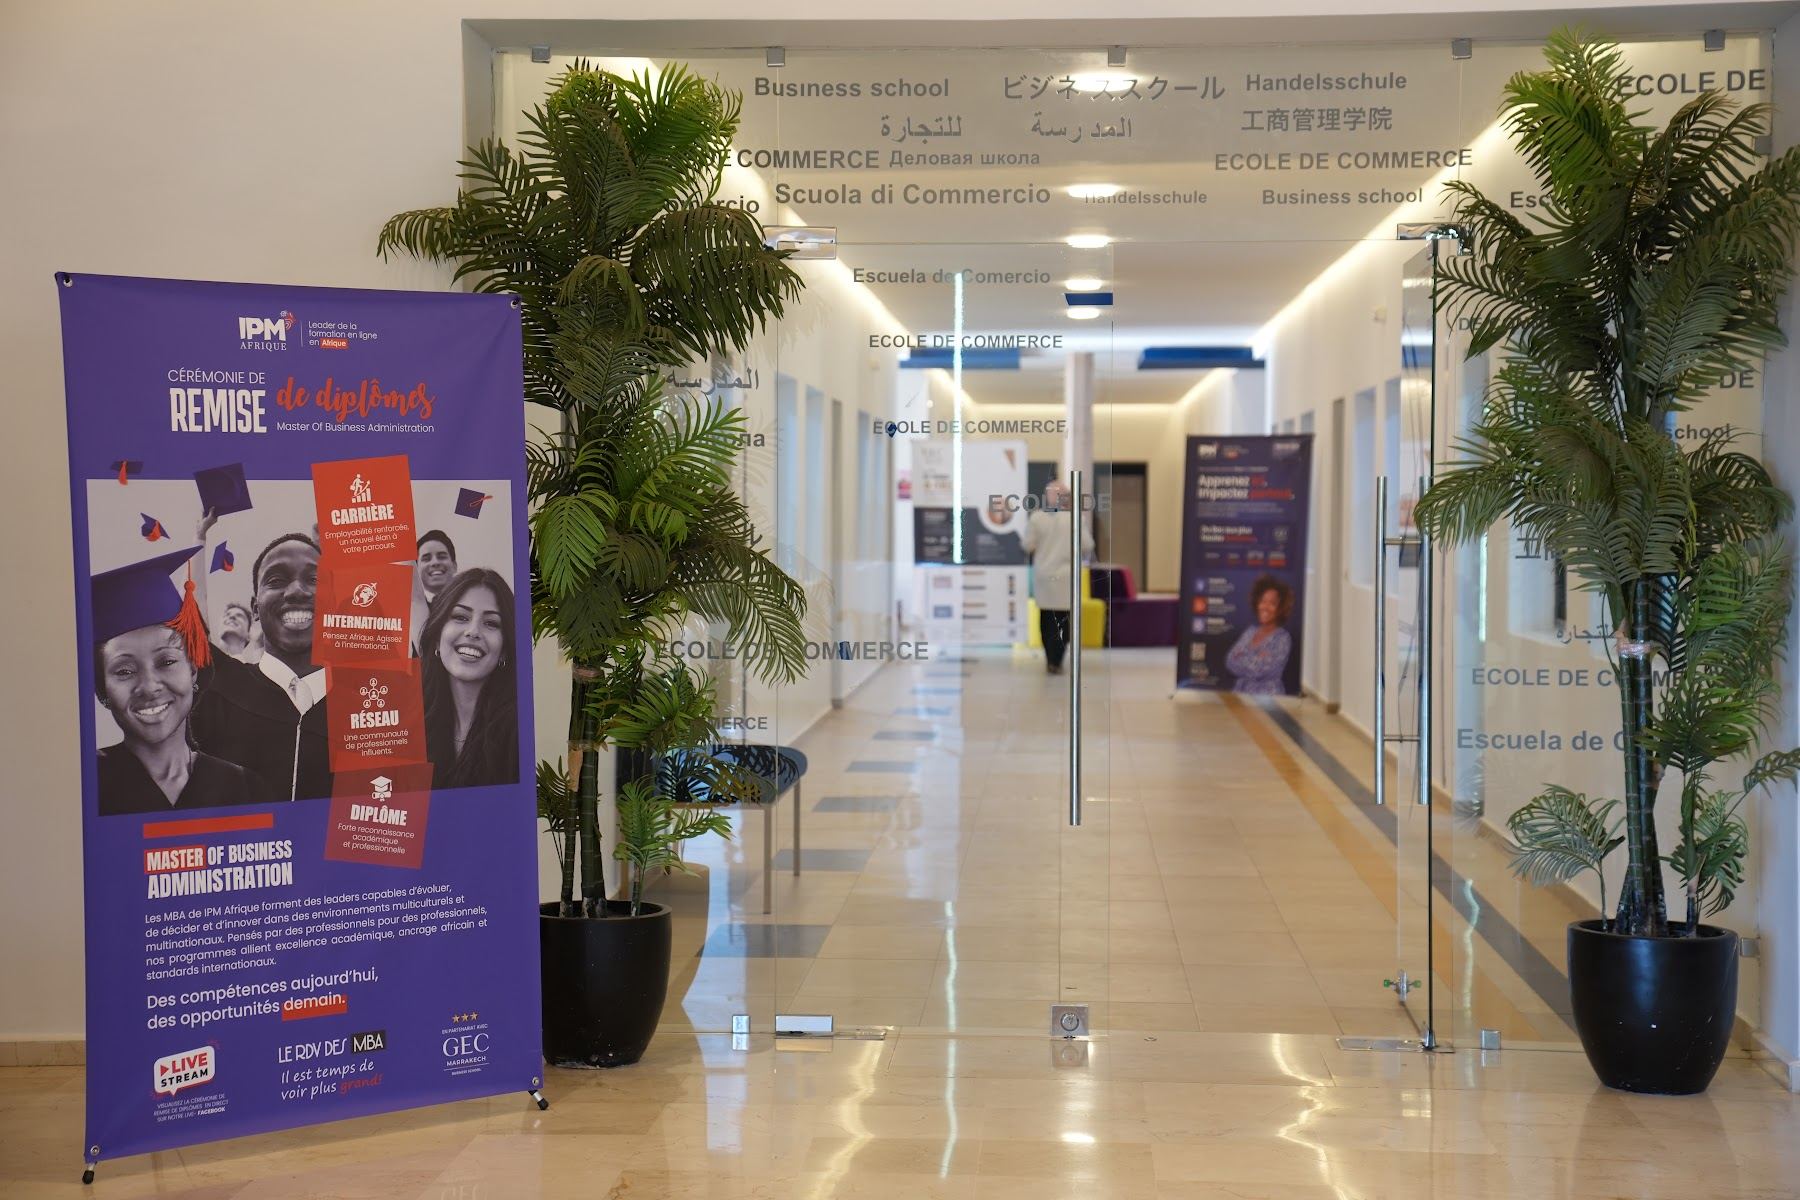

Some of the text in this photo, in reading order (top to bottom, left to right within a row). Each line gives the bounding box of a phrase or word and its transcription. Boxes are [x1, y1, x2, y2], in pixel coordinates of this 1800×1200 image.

[754, 77, 949, 97] Business school
[1246, 72, 1407, 92] Handelsschule
[1618, 69, 1766, 96] ECOLE DE
[880, 114, 962, 144] للتجارة
[1241, 107, 1393, 132] 工商管理学院
[737, 150, 880, 169] COMMERCE
[889, 150, 1040, 168] Деловая школа
[1215, 149, 1473, 171] ECOLE DE COMMERCE
[775, 183, 1051, 205] Scuola di Commercio
[1262, 188, 1423, 205] Business school
[853, 268, 1050, 284] Escuela de Comercio
[238, 316, 286, 341] IPM
[308, 320, 357, 330] Leader de la
[308, 330, 346, 338] formation
[360, 331, 378, 341] ligne
[322, 340, 347, 348] Afrique
[869, 335, 1063, 348] ECOLE DE COMMERCE
[240, 342, 287, 352] AFRIQUE
[168, 368, 266, 384] CÉRÉMONIE DE
[1720, 368, 1754, 389] DE
[276, 376, 438, 423] de diplômes
[170, 388, 267, 434] REMISE
[276, 422, 435, 434] Master Of Business Administration
[873, 420, 1066, 436] ECOLE DE COMMERCE
[988, 494, 1111, 512] ECOLE DE
[330, 503, 395, 526] CARRIÈRE
[324, 523, 410, 540] Employabilité renforcée,
[339, 532, 398, 546] un nouvel élan à
[342, 543, 396, 554] votre parcours.
[323, 614, 403, 632] INTERNATIONAL
[322, 632, 348, 641] Pensez
[376, 634, 403, 644] Agissez
[334, 640, 340, 648] à
[801, 641, 929, 661] OMMERCE
[1471, 668, 1550, 686] ECOLE
[1558, 668, 1589, 686] DE
[350, 709, 400, 730] RÉSEAU
[343, 728, 409, 742] Une communauté
[345, 738, 408, 750] de professionnels
[1457, 728, 1562, 750] Escuela
[1571, 730, 1604, 751] de
[362, 746, 394, 756] influents.
[350, 804, 408, 826] DIPLÔME
[338, 822, 415, 839] Forte reconnaissance
[352, 834, 399, 846] académique
[146, 839, 293, 872] MASTER OF BUSINESS
[352, 842, 406, 855] professionnelle
[148, 862, 293, 900] ADMINISTRATION
[145, 914, 162, 924] Les
[164, 910, 186, 921] MBA
[188, 908, 202, 919] de
[204, 907, 222, 918] IPM
[224, 904, 260, 917] Afrique
[262, 898, 302, 911] forment
[304, 896, 322, 906] des
[324, 893, 360, 904] leaders
[362, 888, 406, 902] capables
[146, 928, 159, 938] de
[162, 924, 200, 936] décider
[202, 922, 213, 932] et
[264, 914, 290, 925] dans
[292, 911, 310, 922] des
[312, 904, 390, 920] environnements
[392, 896, 454, 912] multiculturels
[455, 895, 465, 904] et
[146, 906, 488, 952] multinationaux. Pensés par des professionnels pour des professionnels,
[146, 918, 488, 966] nos programmes allient excellence académique, ancrage africain et
[146, 957, 277, 980] standards internationaux.
[147, 994, 176, 1010] Des
[180, 980, 287, 1006] compétences
[147, 991, 346, 1030] des opportunités demain.
[278, 1046, 293, 1064] LE
[295, 1042, 322, 1061] RDV
[353, 1033, 384, 1053] MBA
[442, 1032, 490, 1057] GEC
[170, 1052, 208, 1074] LIVE
[281, 1058, 374, 1084] Il est temps de
[446, 1056, 486, 1066] MARRAKECH
[160, 1068, 208, 1088] STREAM
[281, 1073, 384, 1100] voir plus grand!
[198, 1106, 226, 1116] FACEBOOK
